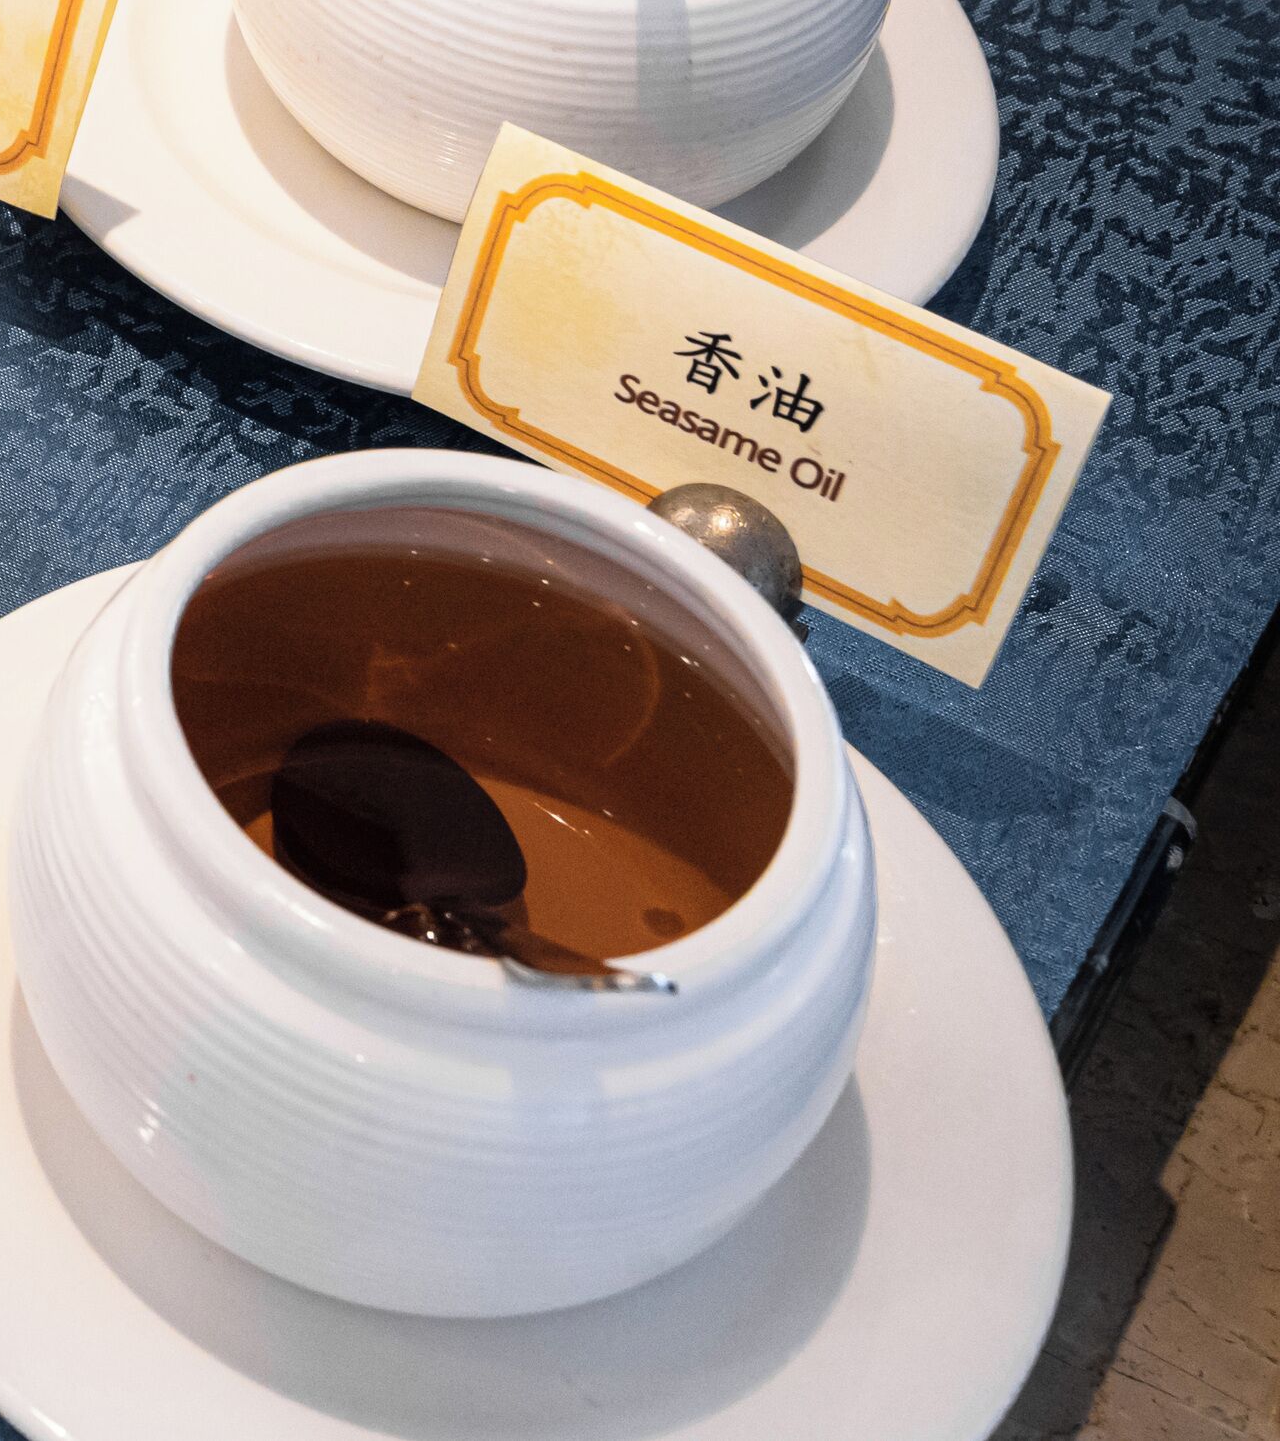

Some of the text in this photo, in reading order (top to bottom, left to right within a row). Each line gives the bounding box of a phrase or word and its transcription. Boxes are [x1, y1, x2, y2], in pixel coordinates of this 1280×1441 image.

[613, 373, 847, 503] Seasame Oil
[672, 330, 826, 434] 香油
